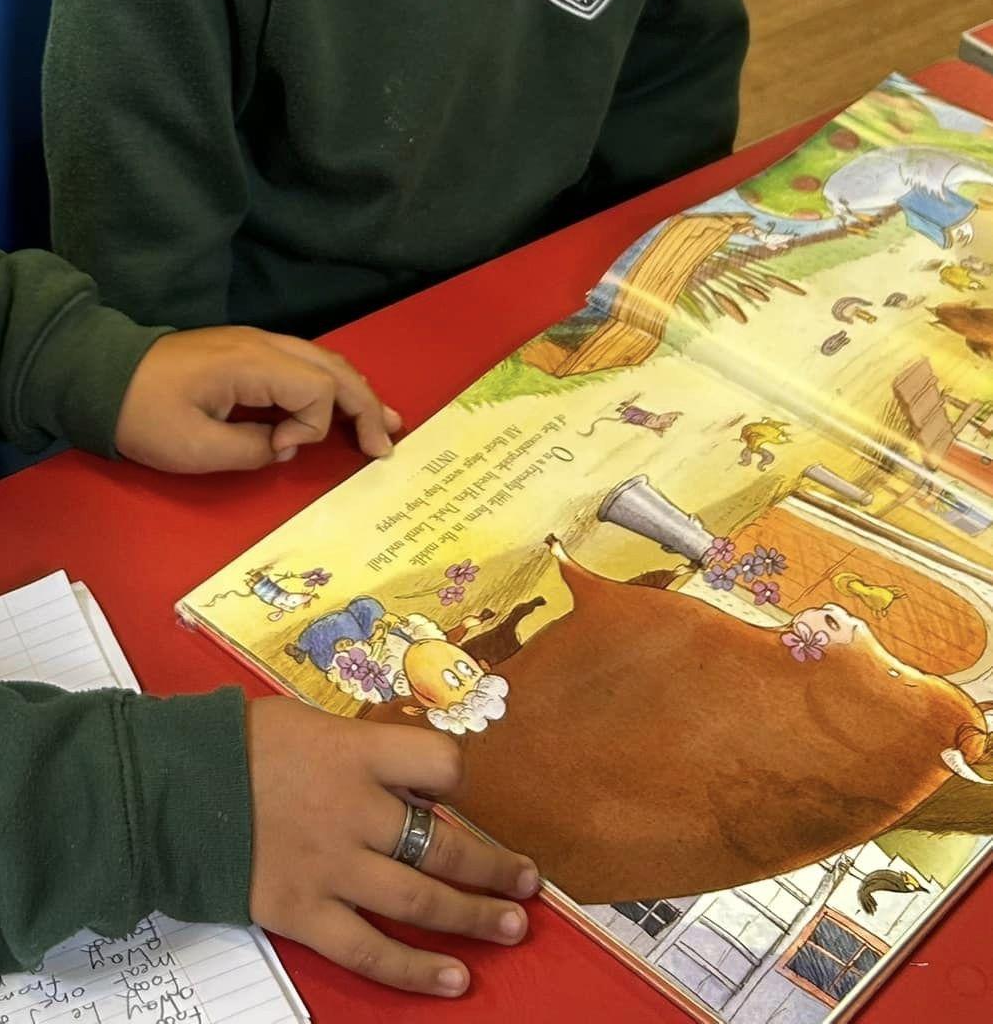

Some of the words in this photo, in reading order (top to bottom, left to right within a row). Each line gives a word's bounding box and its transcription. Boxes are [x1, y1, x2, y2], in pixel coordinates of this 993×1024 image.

[502, 424, 523, 440] All
[503, 463, 544, 491] friendly
[486, 489, 513, 507] little
[437, 530, 460, 544] the
[385, 539, 406, 558] and
[408, 542, 440, 566] middle
